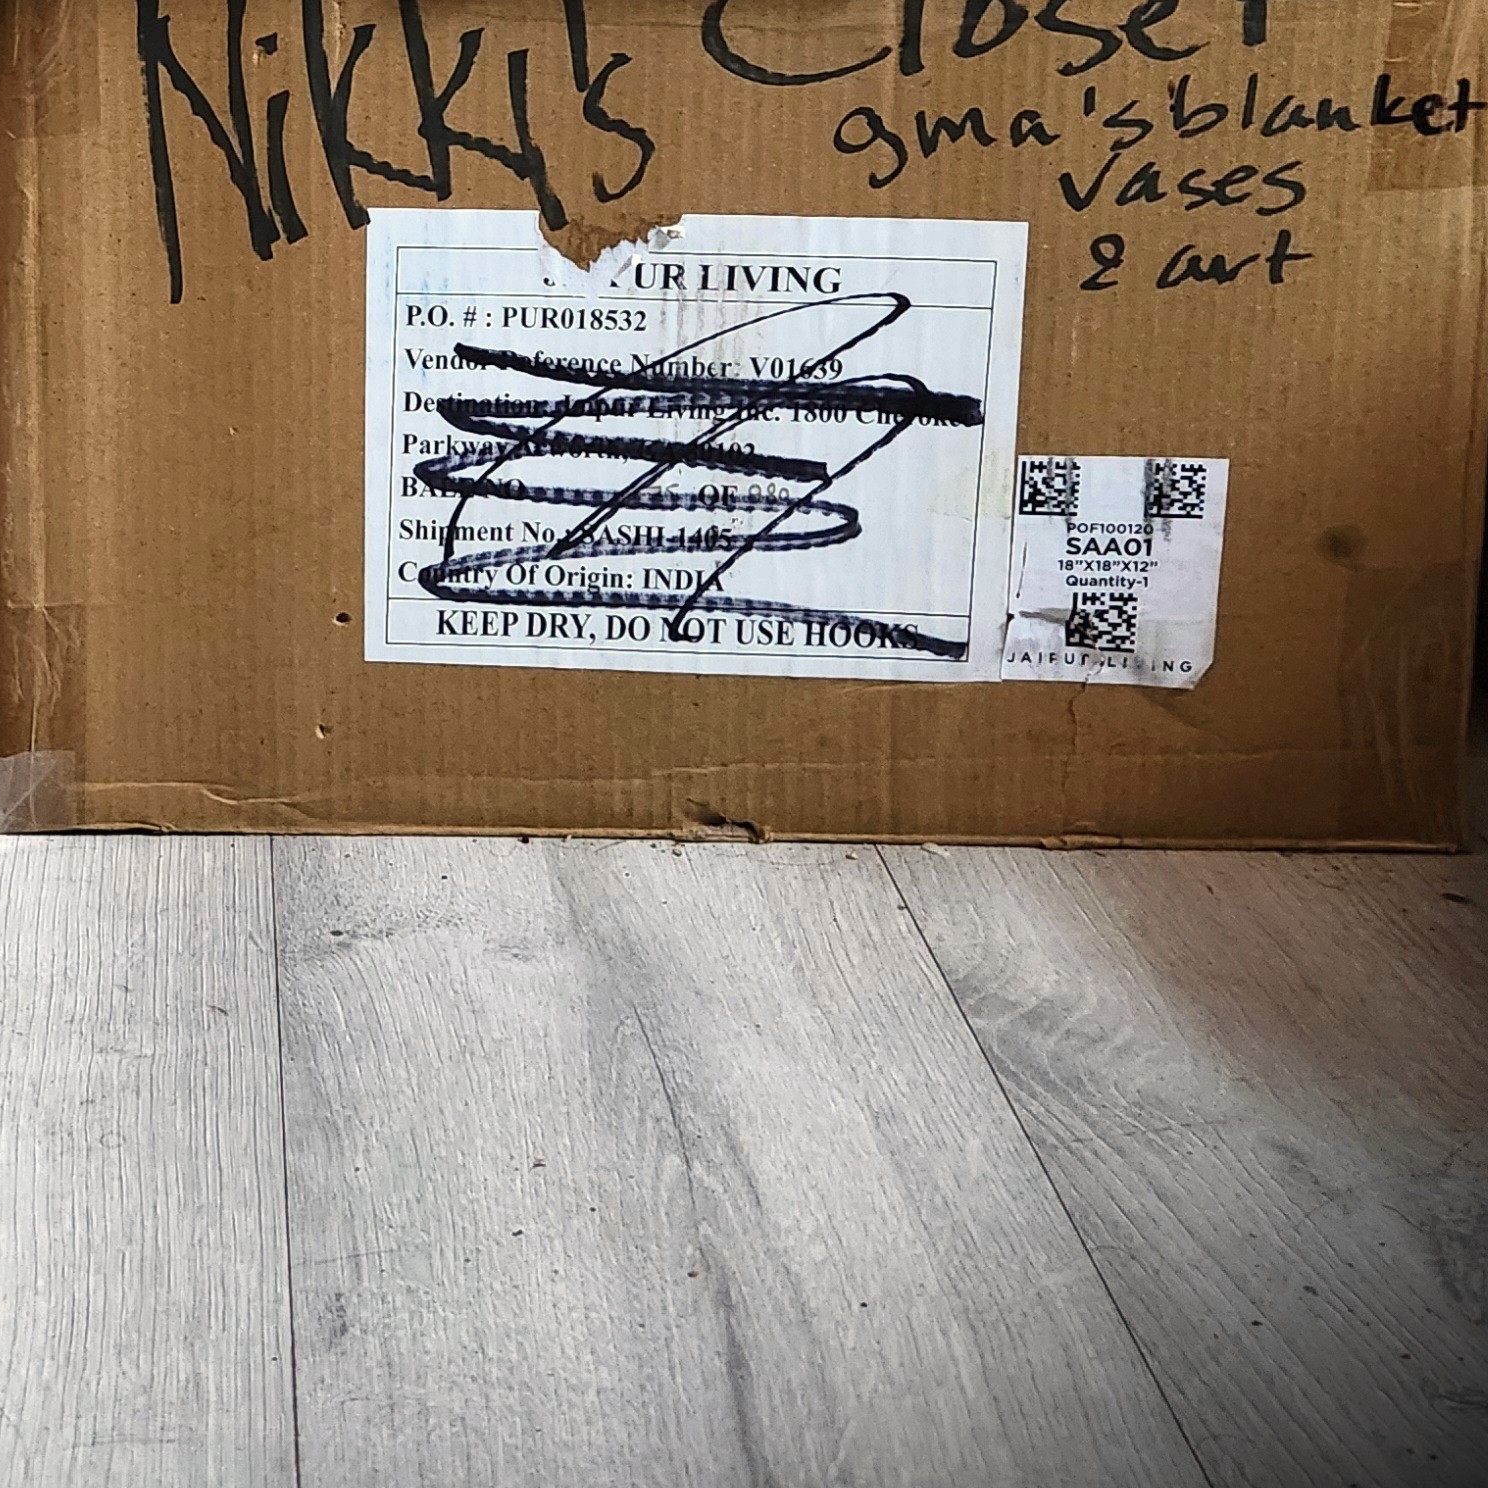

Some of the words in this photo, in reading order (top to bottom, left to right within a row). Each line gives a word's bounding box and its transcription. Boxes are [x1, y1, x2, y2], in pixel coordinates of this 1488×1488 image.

[1156, 228, 1313, 290] art
[698, 263, 842, 295] LIVING
[405, 304, 455, 328] P.O.
[502, 306, 647, 332] PUR018532
[405, 348, 487, 371] Vendo
[501, 350, 622, 376] ference
[698, 483, 739, 507] OF
[399, 519, 514, 546] Shipment
[1066, 522, 1154, 535] POF100120
[506, 561, 538, 586] Of
[545, 563, 634, 593] Origin:
[643, 567, 725, 593] INDIA
[1065, 574, 1149, 590] Quantity-1
[436, 609, 519, 637] KEEP
[526, 611, 596, 644] DRY,
[606, 615, 652, 642] DO
[659, 617, 727, 644] NOT
[735, 619, 796, 646] USE
[803, 621, 919, 650] HOOKS
